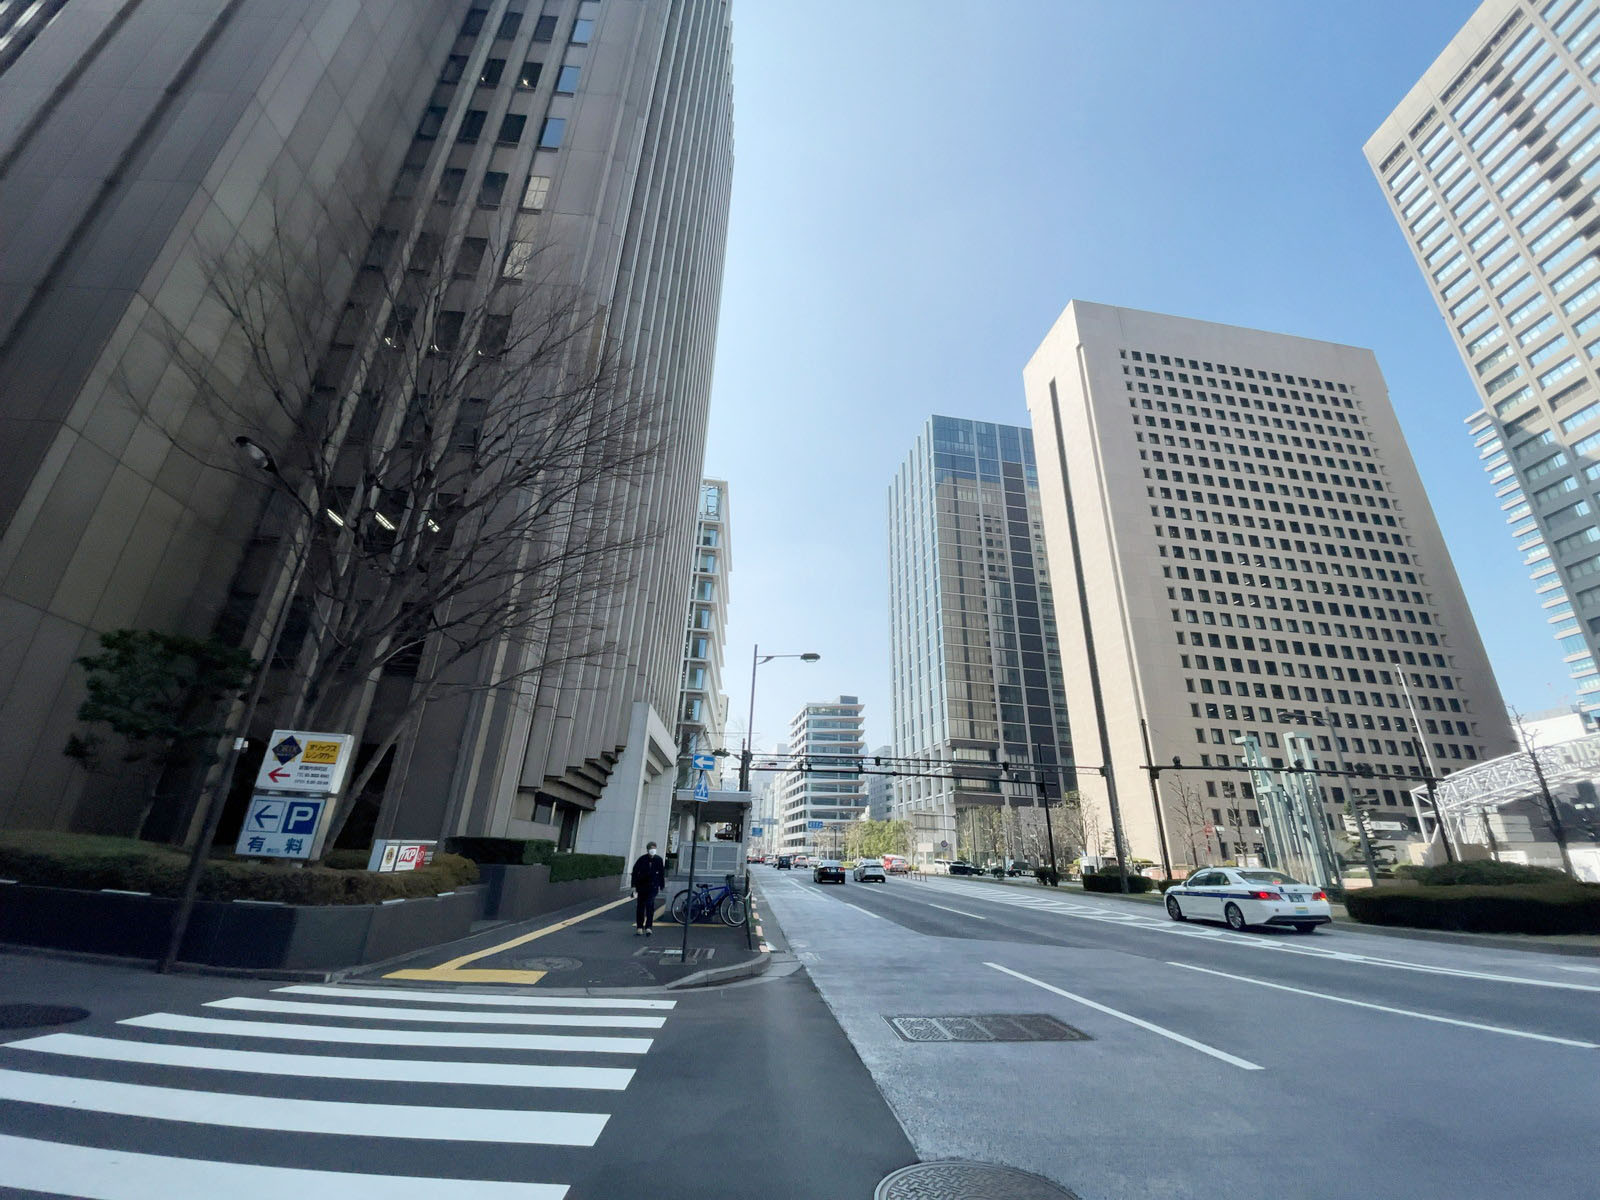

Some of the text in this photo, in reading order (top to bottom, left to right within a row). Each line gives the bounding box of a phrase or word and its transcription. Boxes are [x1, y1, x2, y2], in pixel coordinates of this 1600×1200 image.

[309, 743, 337, 752] オリックス
[305, 752, 335, 760] レンタカー
[287, 805, 314, 830] P
[247, 835, 304, 855] 有料
